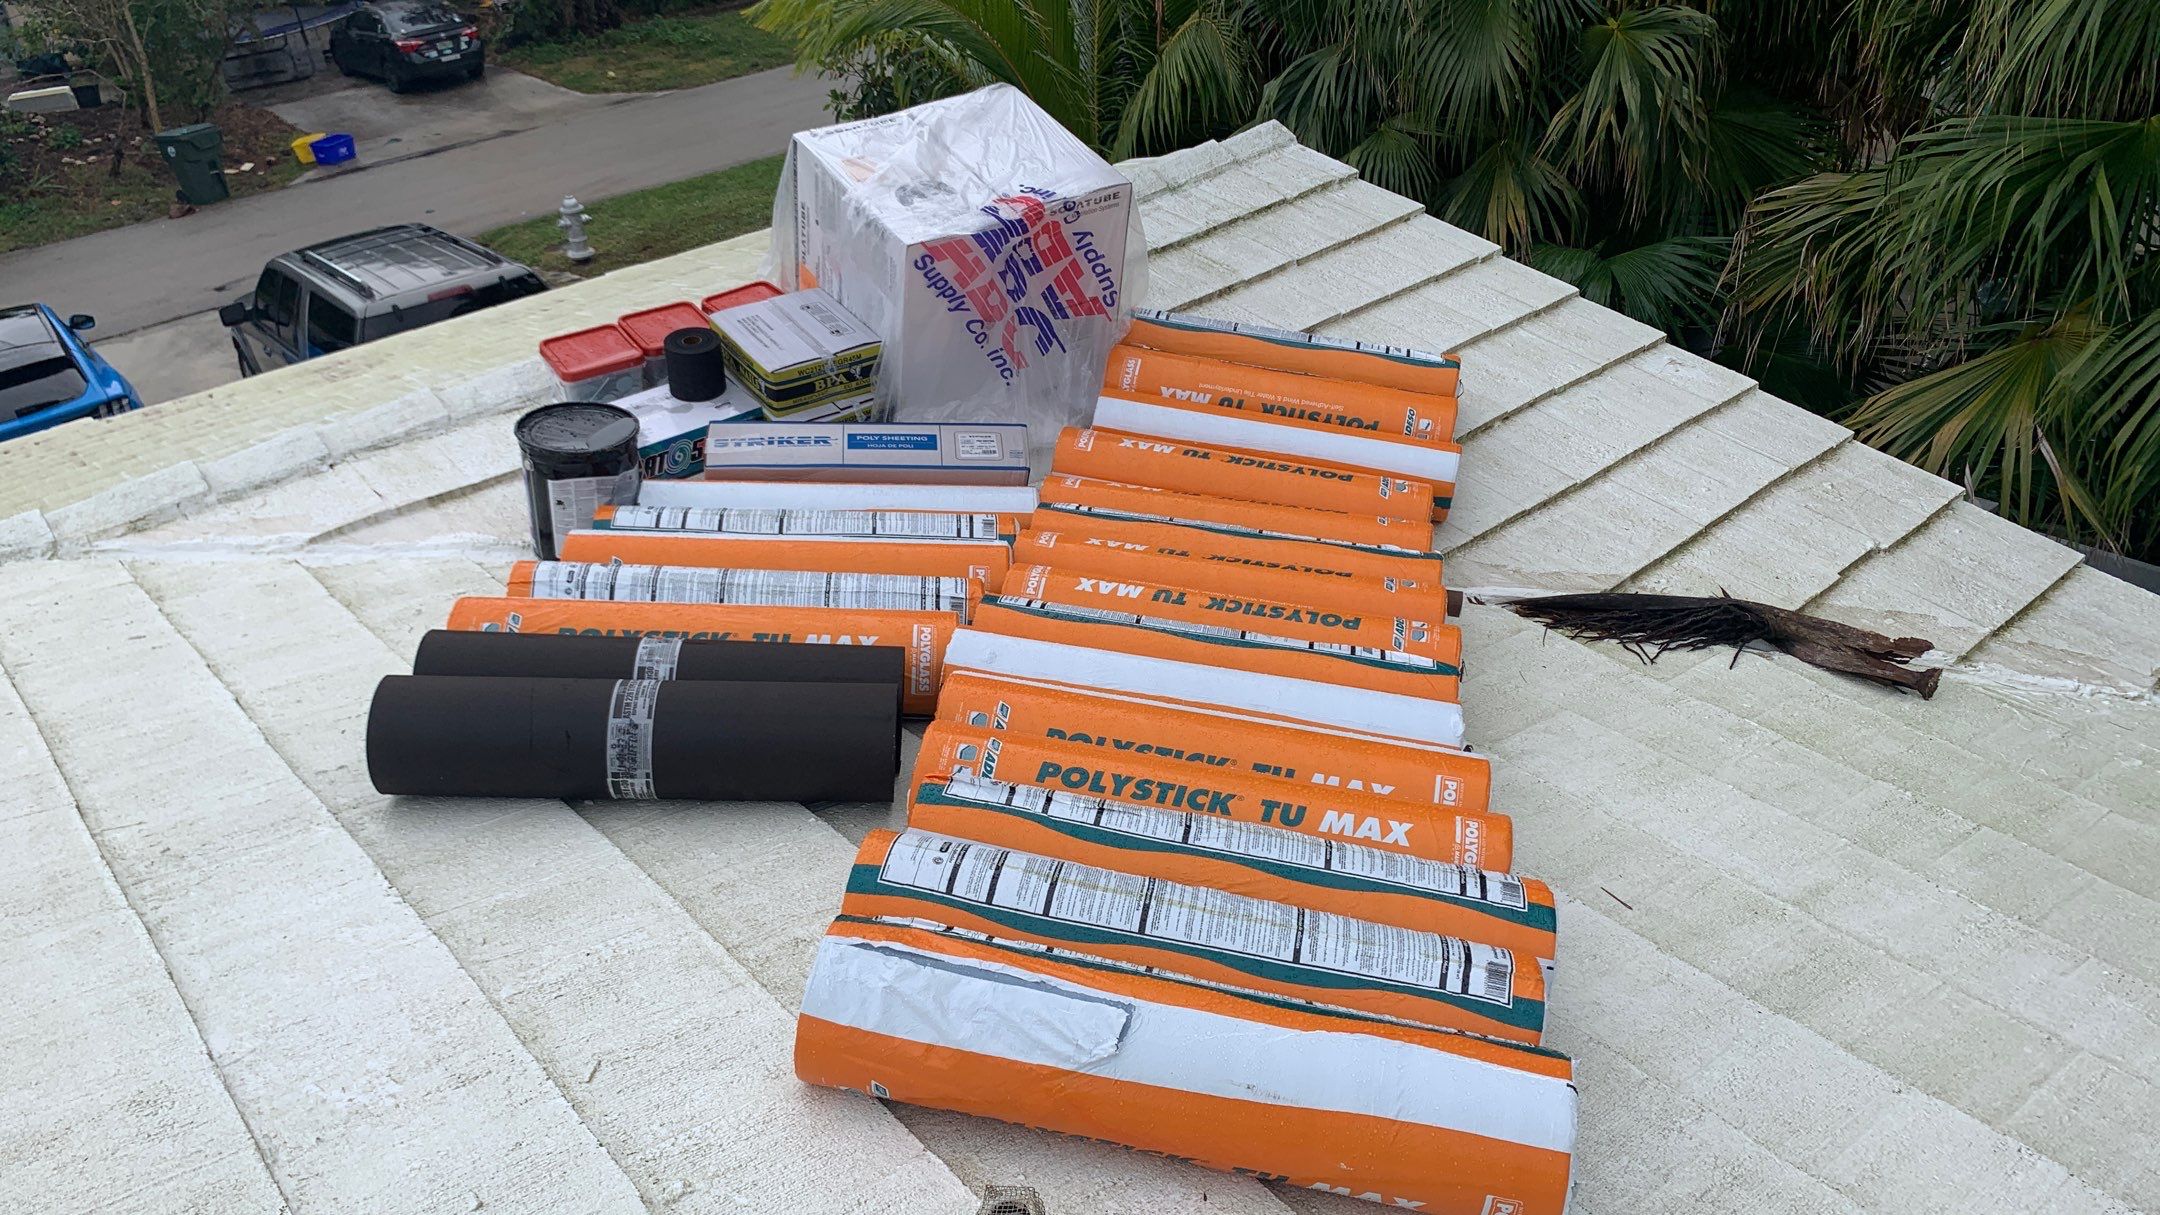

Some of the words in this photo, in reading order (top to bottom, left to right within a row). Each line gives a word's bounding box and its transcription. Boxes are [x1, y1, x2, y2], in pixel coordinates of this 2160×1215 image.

[1072, 230, 1118, 308] Supply
[913, 253, 971, 313] Supply
[965, 319, 988, 350] Co.
[713, 436, 832, 447] STRIKER
[1117, 437, 1177, 454] MAX
[1182, 449, 1211, 460] TU
[1225, 454, 1354, 483] POLYSTICK
[1085, 537, 1149, 551] MAX
[1157, 547, 1191, 558] TU
[1208, 552, 1353, 578] POLYSTICK
[1073, 576, 1146, 599] MAX
[1151, 589, 1187, 606] TU
[1204, 596, 1362, 631] POLYSTICK
[919, 626, 931, 692] POLYGLASS
[1035, 761, 1237, 816] POLYSTICK
[1261, 799, 1307, 827] TU
[1318, 809, 1415, 847] MAX
